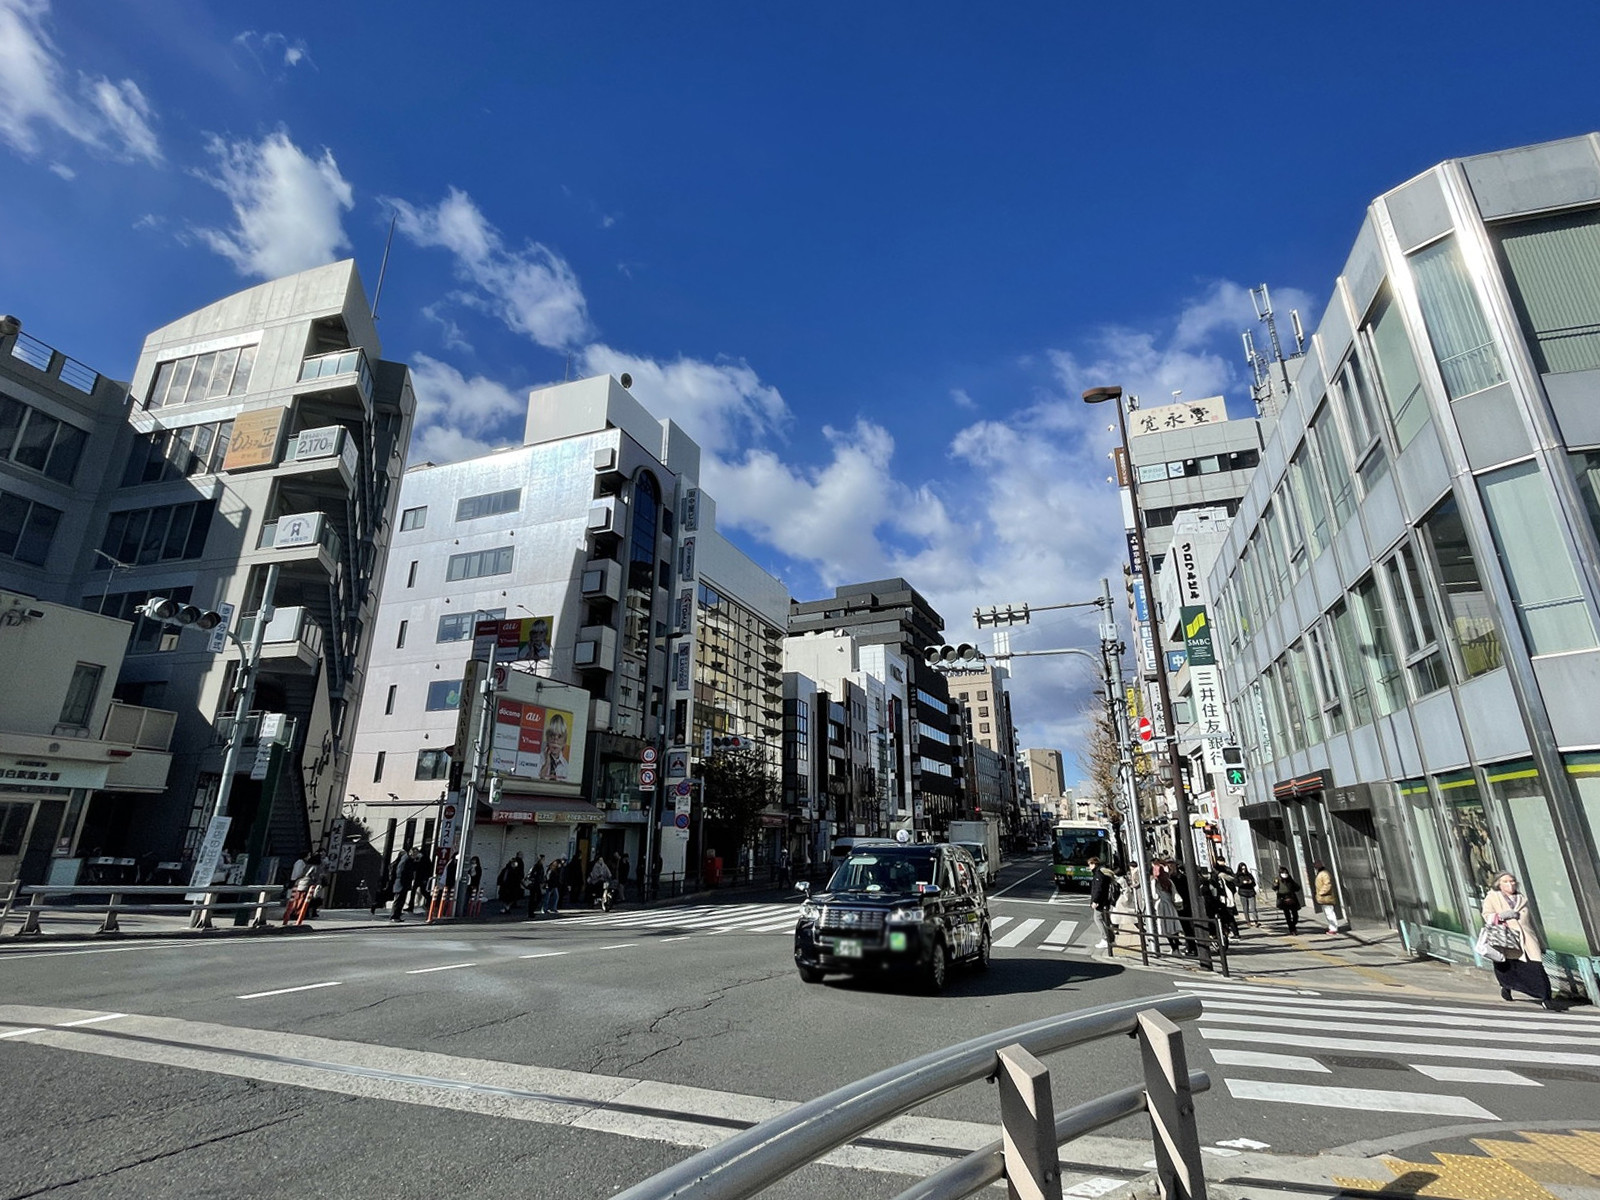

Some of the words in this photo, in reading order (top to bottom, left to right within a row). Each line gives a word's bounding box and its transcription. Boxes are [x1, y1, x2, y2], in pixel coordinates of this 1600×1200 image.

[503, 623, 518, 631] au
[1187, 638, 1211, 647] SMBC
[499, 707, 521, 718] docomo
[525, 712, 541, 721] au
[1197, 671, 1223, 766] 三井住友銀行
